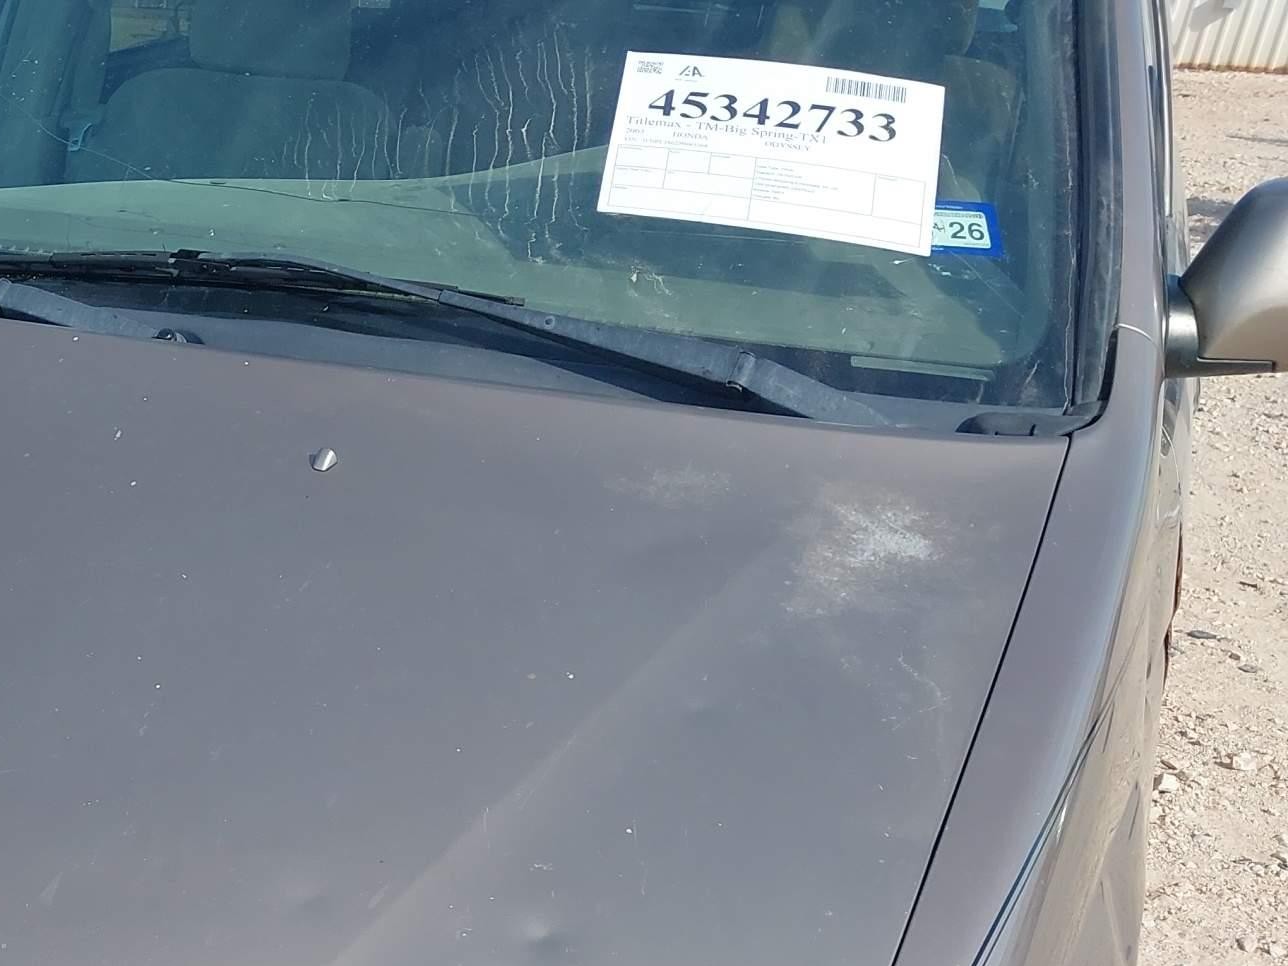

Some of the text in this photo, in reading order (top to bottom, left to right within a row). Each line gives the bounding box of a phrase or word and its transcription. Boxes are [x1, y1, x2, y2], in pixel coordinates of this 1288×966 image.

[626, 115, 681, 129] Titlemax
[695, 120, 747, 136] TM-Big
[751, 127, 827, 144] Spring-TX1
[648, 89, 897, 143] 45342733
[948, 221, 985, 241] 26
